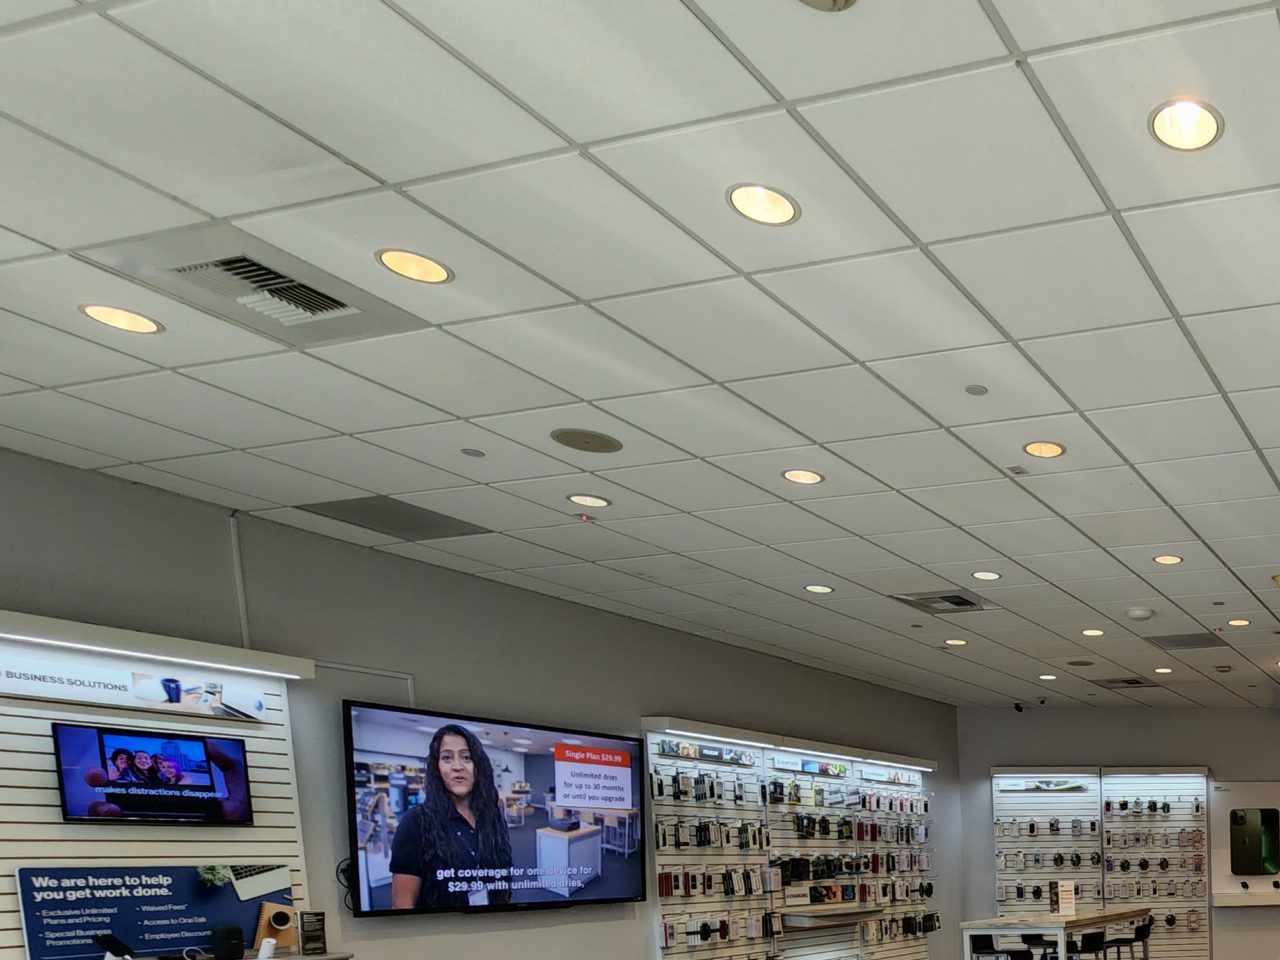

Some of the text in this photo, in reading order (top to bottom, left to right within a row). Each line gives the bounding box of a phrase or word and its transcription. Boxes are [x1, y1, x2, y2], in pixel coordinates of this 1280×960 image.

[5, 671, 129, 692] BUSINESS SOLUTIONS
[565, 750, 622, 762] Single Plan $29.99
[570, 771, 601, 780] Unlimited
[95, 786, 126, 795] makes
[128, 787, 180, 796] distractions
[436, 868, 455, 880] get
[457, 868, 510, 879] coverage
[510, 867, 524, 876] for
[527, 867, 545, 876] one
[580, 865, 593, 875] for
[31, 875, 172, 888] We are here to help
[448, 878, 584, 892] $29.99 with unlimited dries,
[33, 886, 172, 902] you get work done.
[42, 907, 117, 917] Exclusive Unlimited
[141, 904, 167, 912] Waived
[43, 917, 64, 925] Plans
[83, 916, 111, 924] Pricing
[44, 928, 112, 939] Special Business
[144, 932, 180, 940] Employee
[46, 938, 93, 947] Promotions
